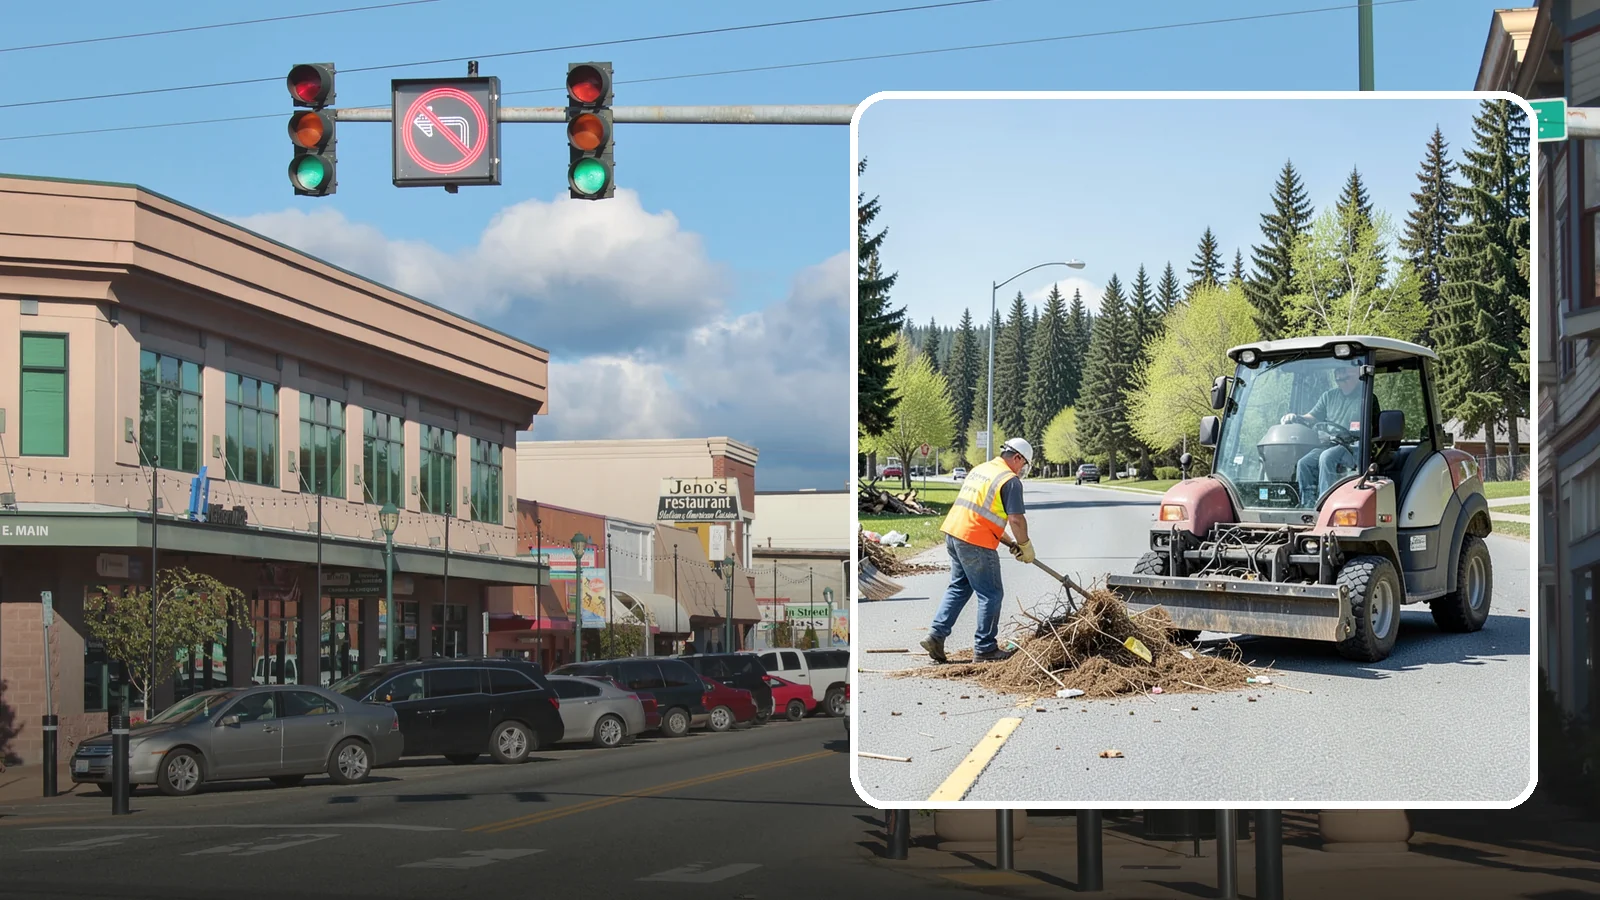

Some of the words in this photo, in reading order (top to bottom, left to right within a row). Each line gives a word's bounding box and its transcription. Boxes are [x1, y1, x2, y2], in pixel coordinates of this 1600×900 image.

[670, 480, 727, 494] Jeno's
[665, 496, 731, 509] restaurant
[658, 510, 681, 519] Italian
[686, 510, 714, 519] American
[715, 510, 737, 519] Cuisine
[2, 525, 13, 536] E.
[15, 525, 49, 536] MAIN
[797, 607, 829, 617] Street
[790, 619, 824, 627] lass
